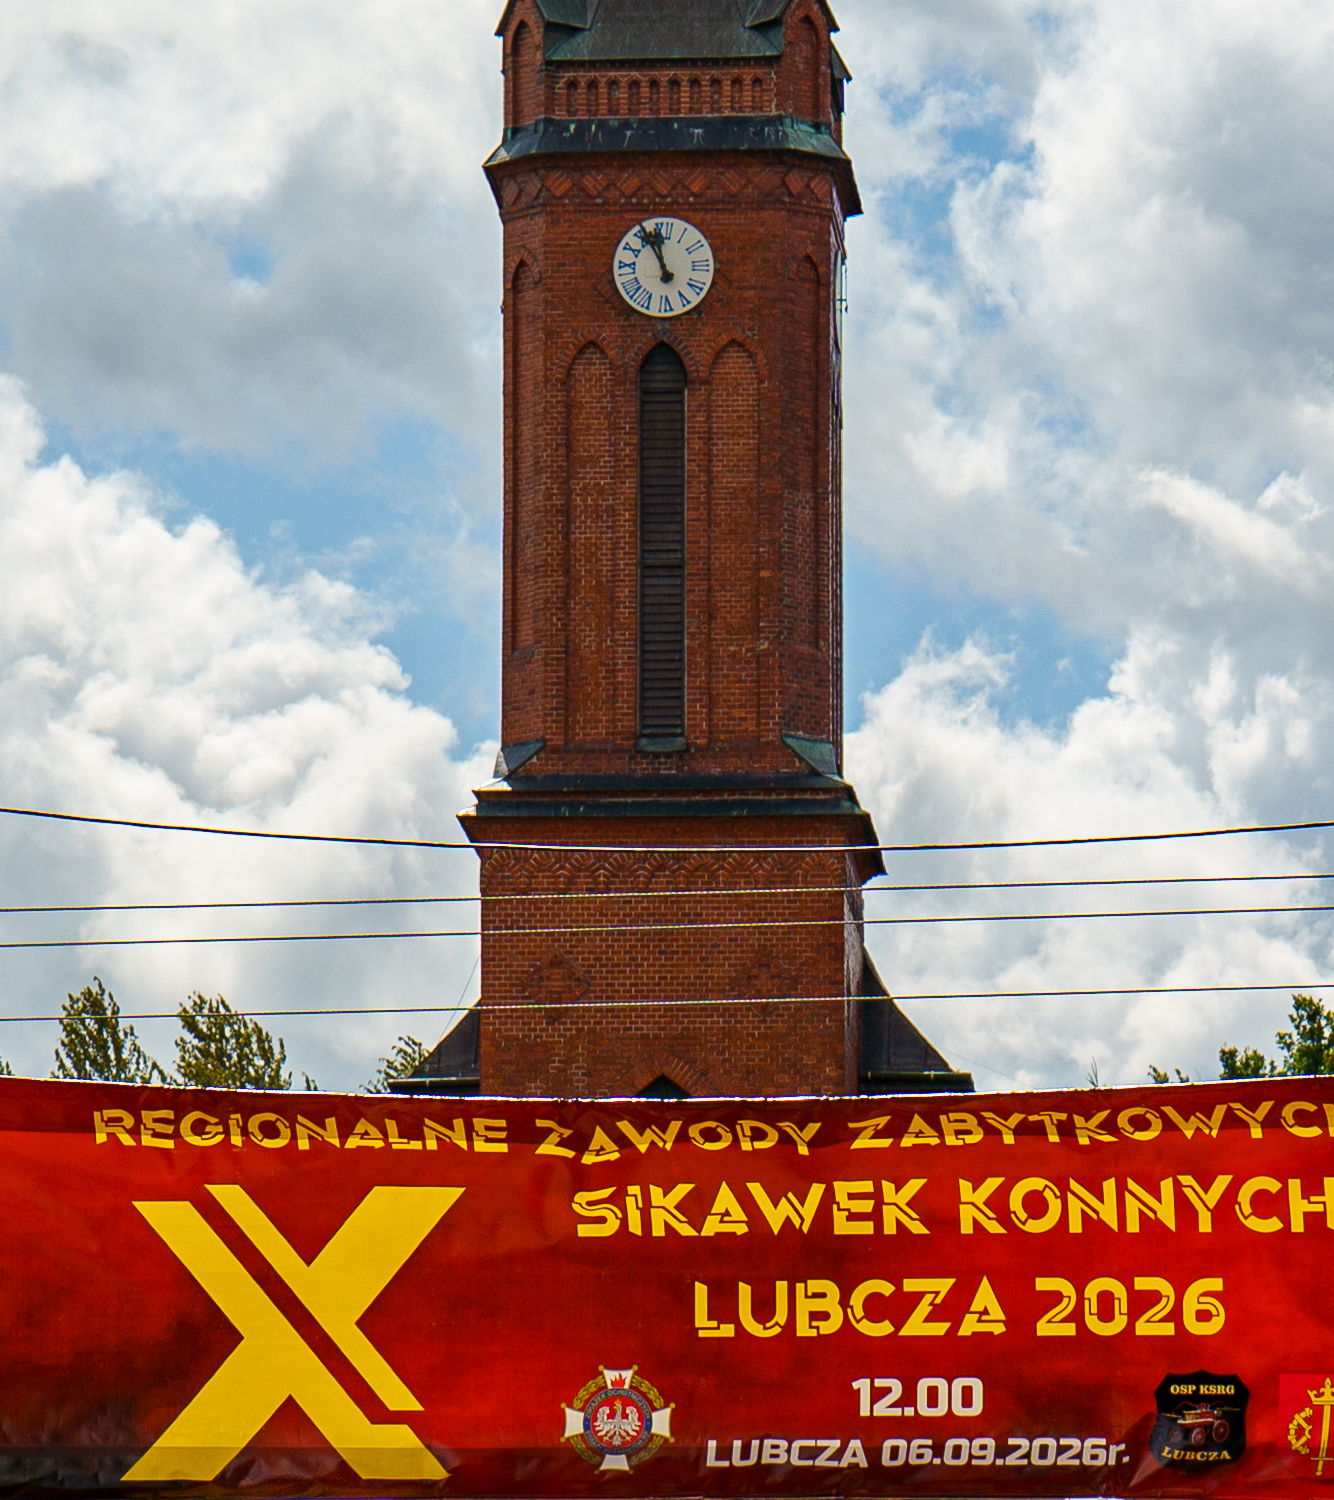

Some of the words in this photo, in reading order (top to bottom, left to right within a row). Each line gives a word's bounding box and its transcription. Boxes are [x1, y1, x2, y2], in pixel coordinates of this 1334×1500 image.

[94, 1109, 508, 1154] REGIONALNE
[535, 1117, 821, 1166] ZAWODY
[571, 1178, 931, 1238] SIKAWEK
[693, 1275, 1009, 1339] LUBCZA
[1034, 1276, 1226, 1338] 2026
[120, 1183, 466, 1482] X
[851, 1376, 984, 1418] 12.00
[1170, 1384, 1196, 1395] OSP
[1199, 1384, 1235, 1395] KSRG
[705, 1438, 868, 1468] LUBCZA
[880, 1436, 1130, 1467] 06.09.2026r.
[1161, 1445, 1232, 1461] LUBCZA
